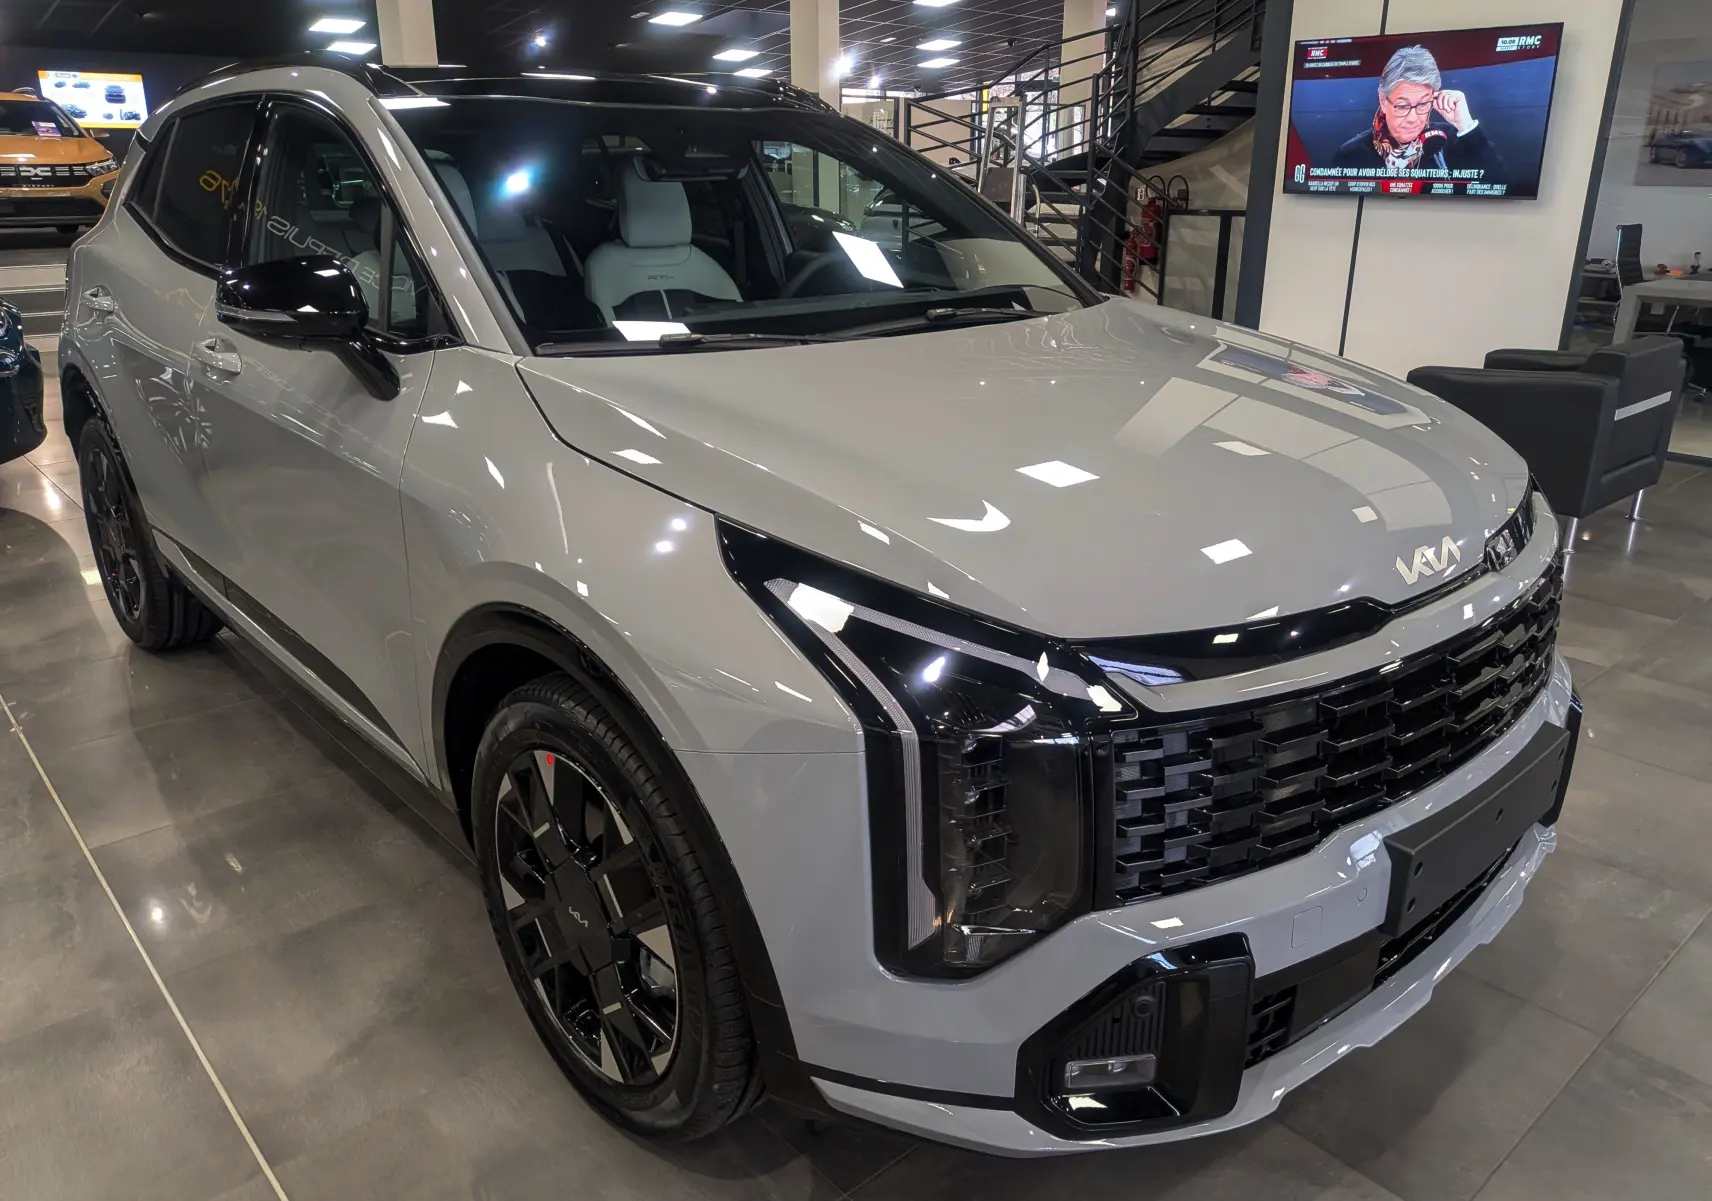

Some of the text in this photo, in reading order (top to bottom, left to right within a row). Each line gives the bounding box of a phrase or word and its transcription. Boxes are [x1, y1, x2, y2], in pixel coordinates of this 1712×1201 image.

[1519, 35, 1542, 45] RMC
[1424, 130, 1444, 138] RMC
[1310, 167, 1342, 176] CONDAMNÉE
[1343, 168, 1358, 177] POUR
[1358, 168, 1376, 177] AVOIR
[1398, 168, 1410, 178] SES
[1410, 168, 1448, 178] SQUATTEURS
[1453, 169, 1478, 178] INJUSTE
[1396, 536, 1461, 585] KIA
